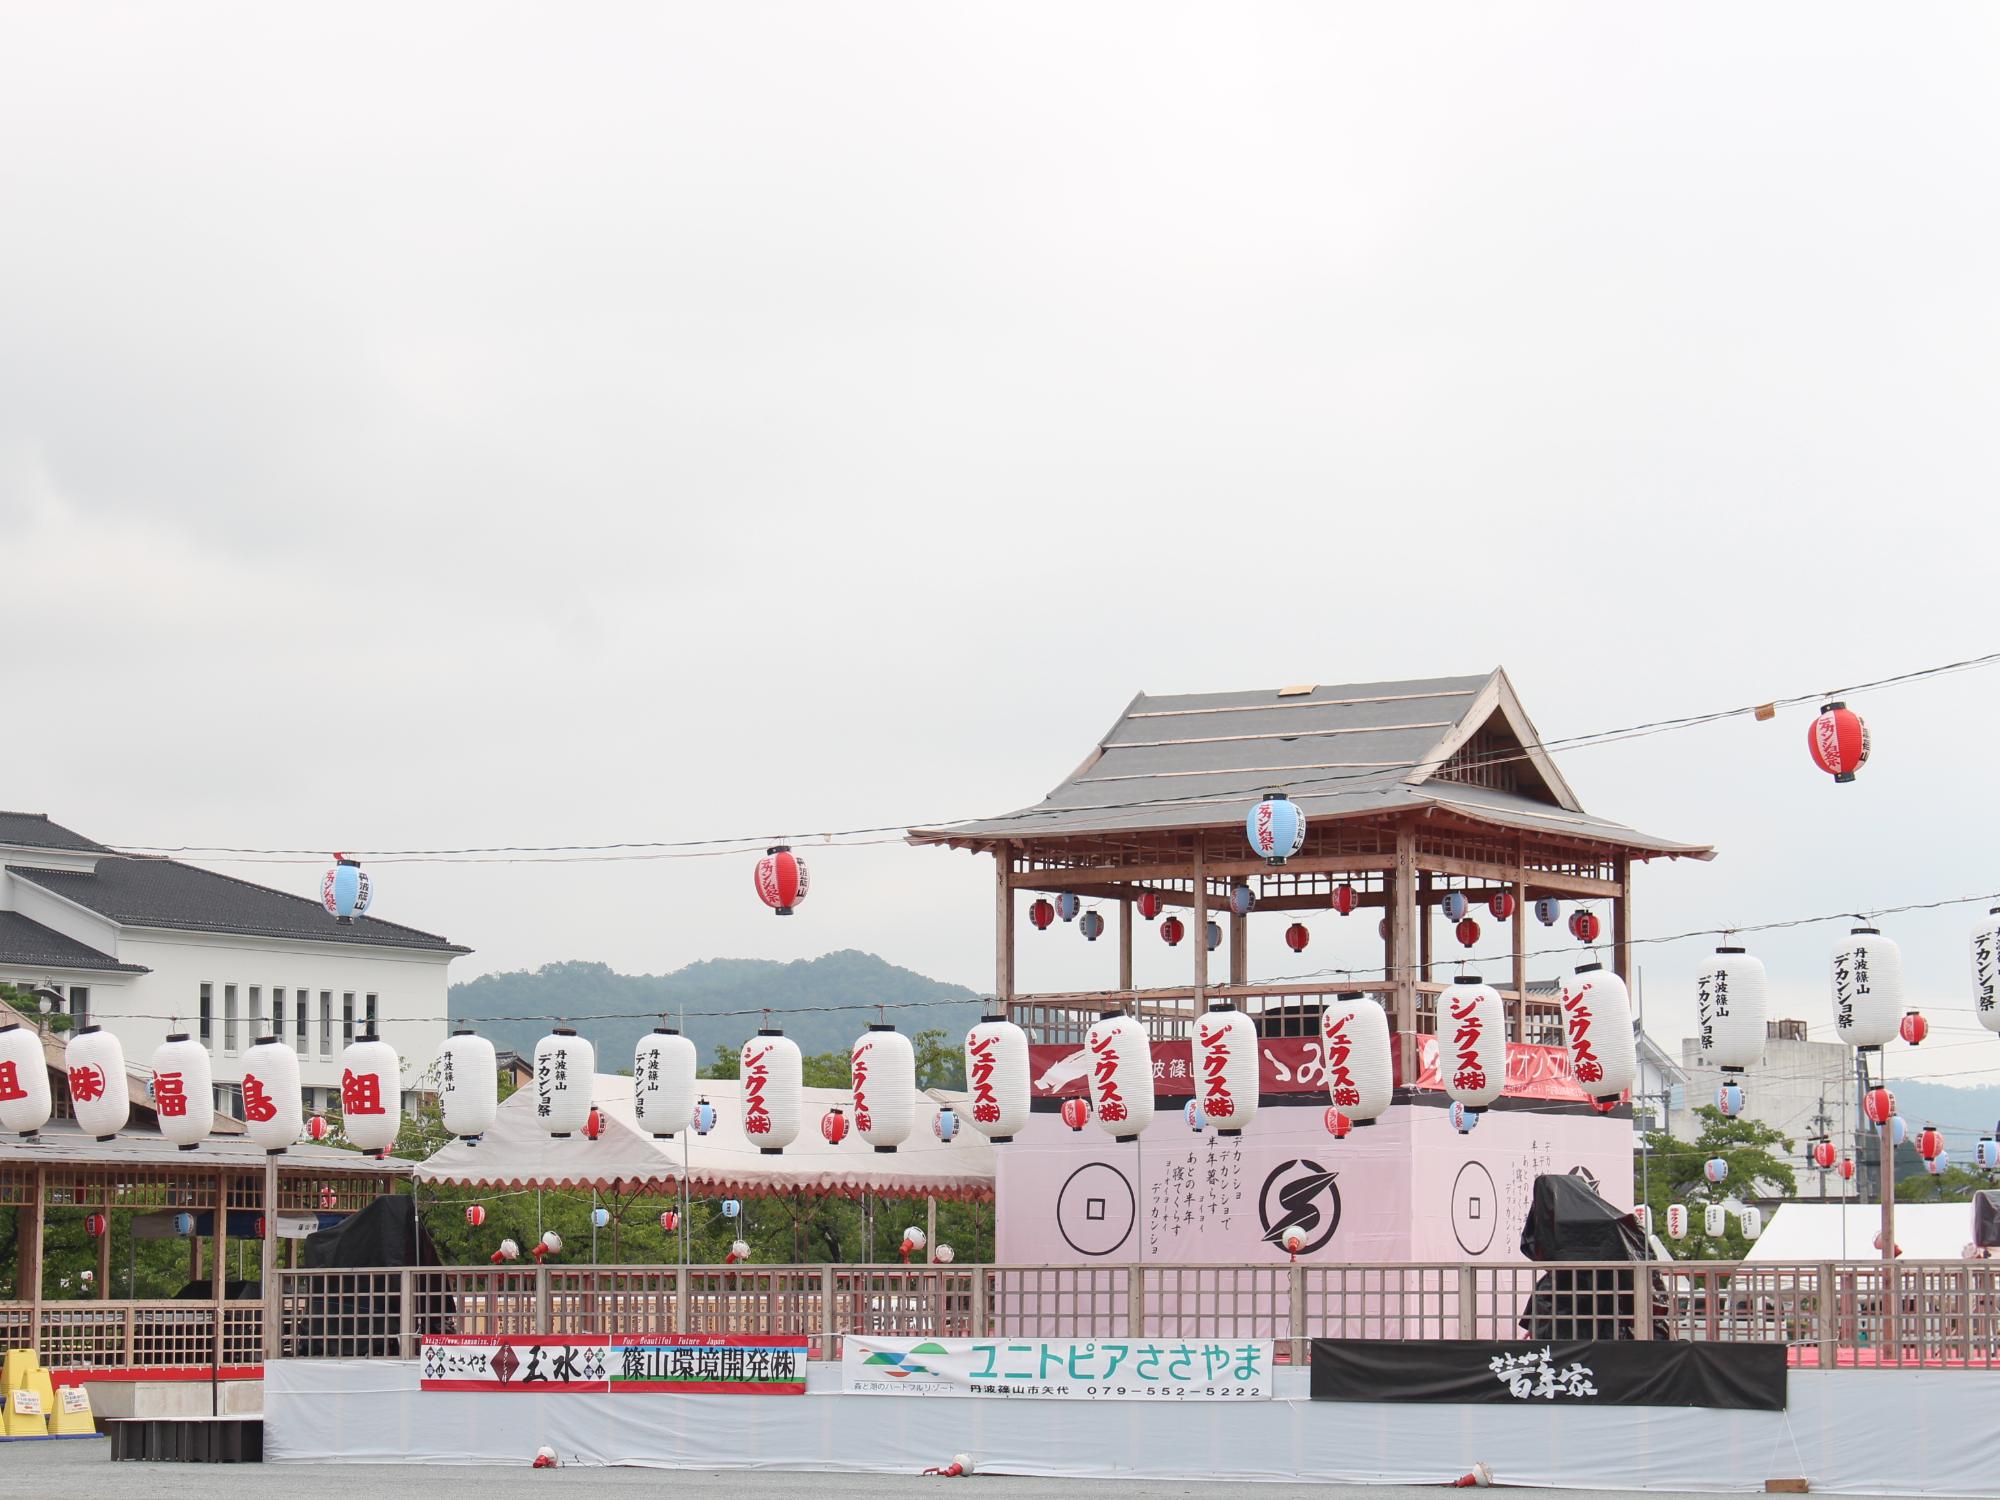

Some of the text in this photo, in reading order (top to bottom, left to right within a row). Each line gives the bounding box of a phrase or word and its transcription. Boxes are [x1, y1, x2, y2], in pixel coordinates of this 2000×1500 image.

[1714, 970, 1729, 1017] 丹波篠山
[1834, 952, 1854, 1029] デカンショ祭
[1853, 947, 1870, 995] 丹波篠山
[1974, 931, 1996, 1012] デカンショ祭
[1698, 975, 1714, 1050] デカンショ祭
[152, 1069, 188, 1117] 福
[341, 1068, 386, 1115] 組
[443, 1051, 455, 1092] 丹波篠山
[537, 1053, 553, 1117] デカンショ祭
[554, 1049, 567, 1091] 丹波篠山
[647, 1049, 660, 1091] 丹波篠山
[241, 1073, 278, 1122] 島
[1184, 1152, 1197, 1224] あとの半年
[1206, 1135, 1219, 1214] 半年暮らす
[1220, 1150, 1231, 1230] デカンショで
[1232, 1136, 1243, 1200] デカンショ
[1151, 1183, 1161, 1254] デッカンショ
[448, 1353, 487, 1373] ささやま
[522, 1344, 582, 1383] 玉水
[622, 1336, 726, 1346] For Beautiful Future Japan
[969, 1343, 1261, 1381] ユニトピアささやま
[970, 1384, 1069, 1395] 丹波篠山市矢代
